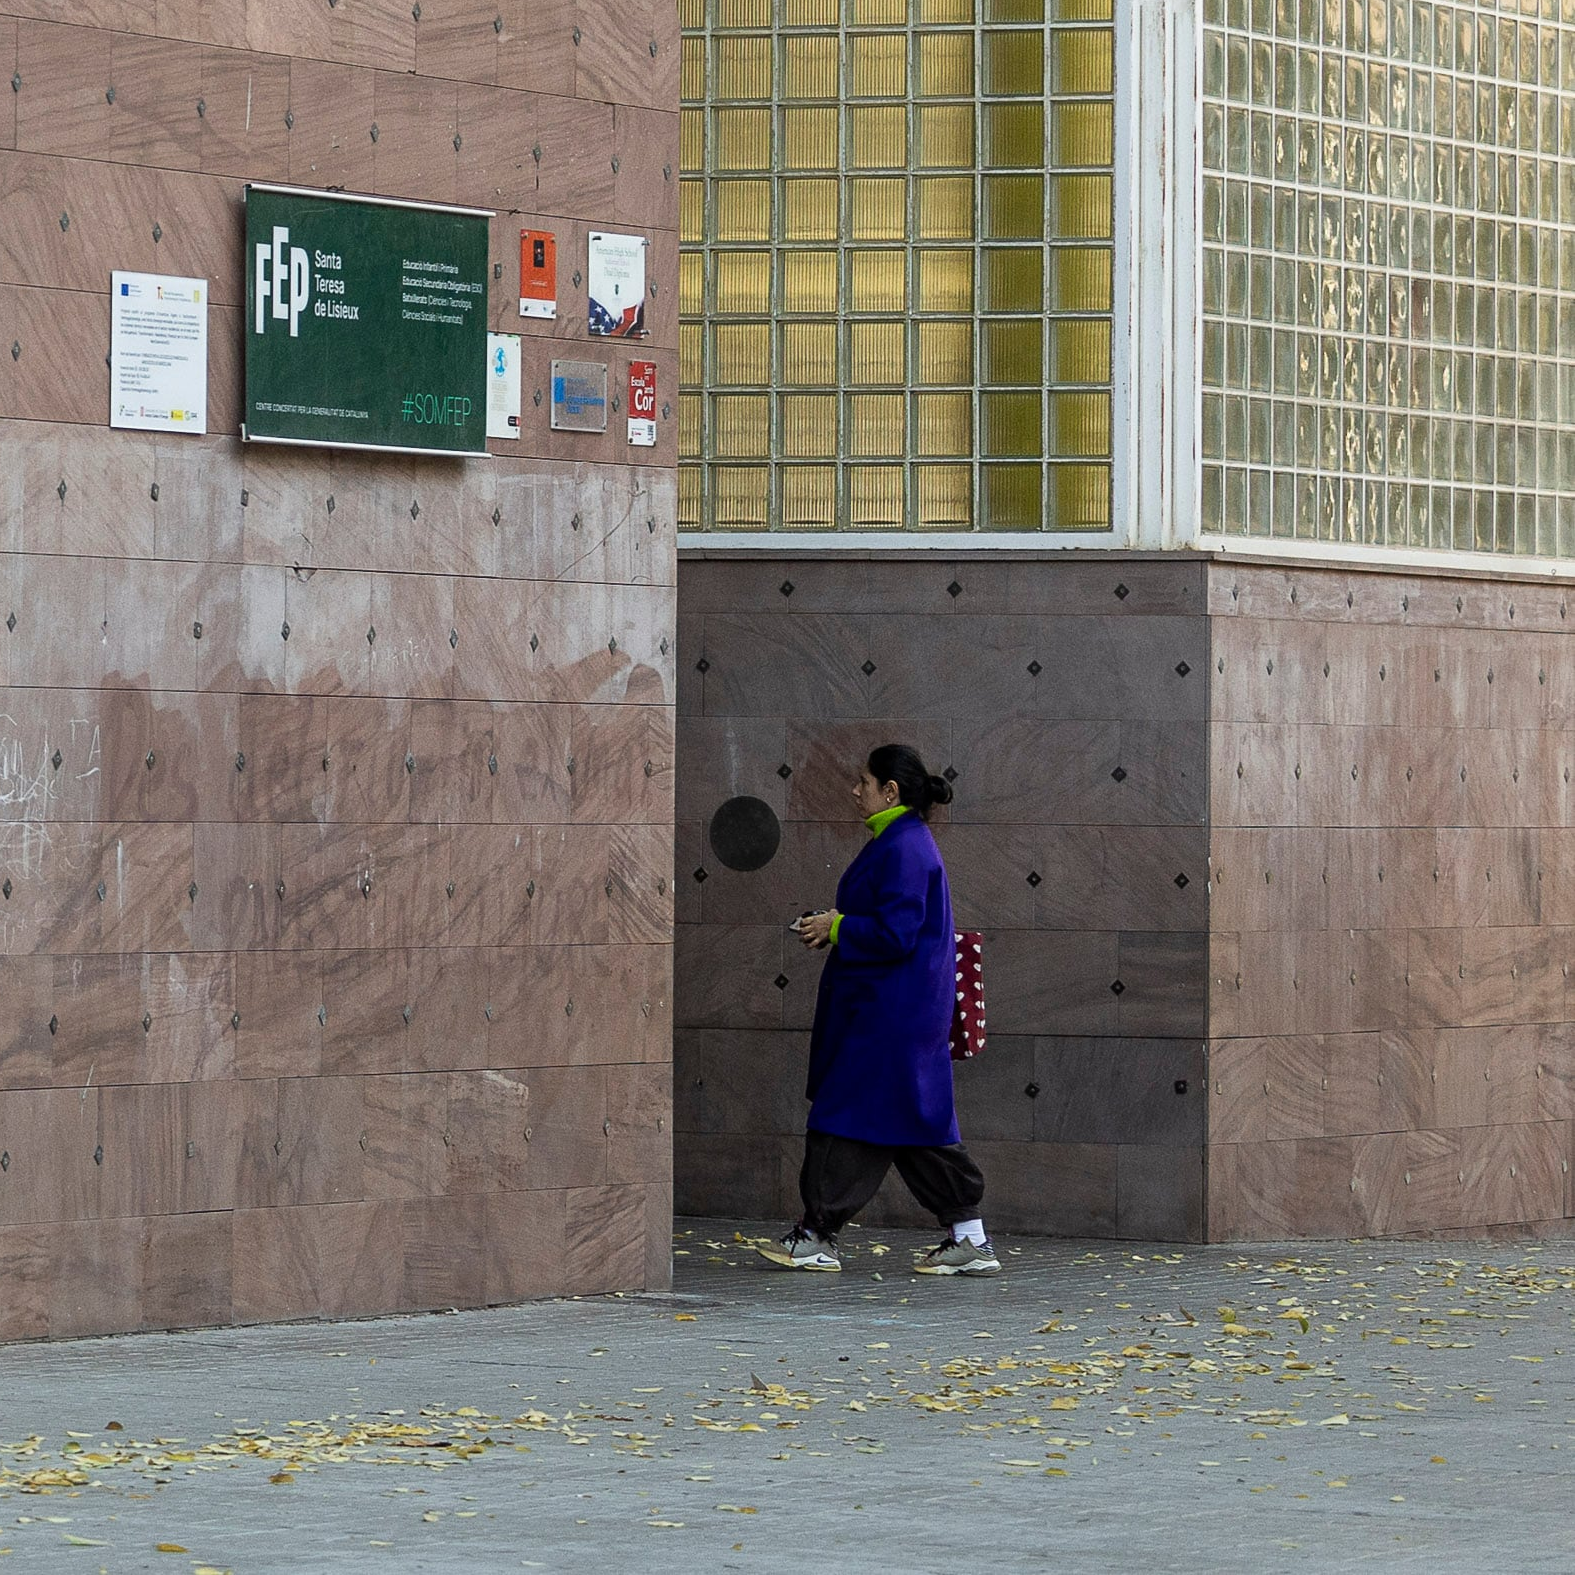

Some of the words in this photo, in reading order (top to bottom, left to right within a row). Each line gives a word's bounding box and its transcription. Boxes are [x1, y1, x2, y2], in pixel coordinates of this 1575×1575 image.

[314, 249, 342, 270] Santa
[255, 226, 310, 337] FEP
[314, 274, 345, 294] Teresa
[314, 299, 327, 317] de
[327, 300, 360, 320] Lisieux
[255, 401, 273, 412] CENTRE
[401, 393, 472, 427] #SOMFEP
[634, 388, 654, 411] Cor
